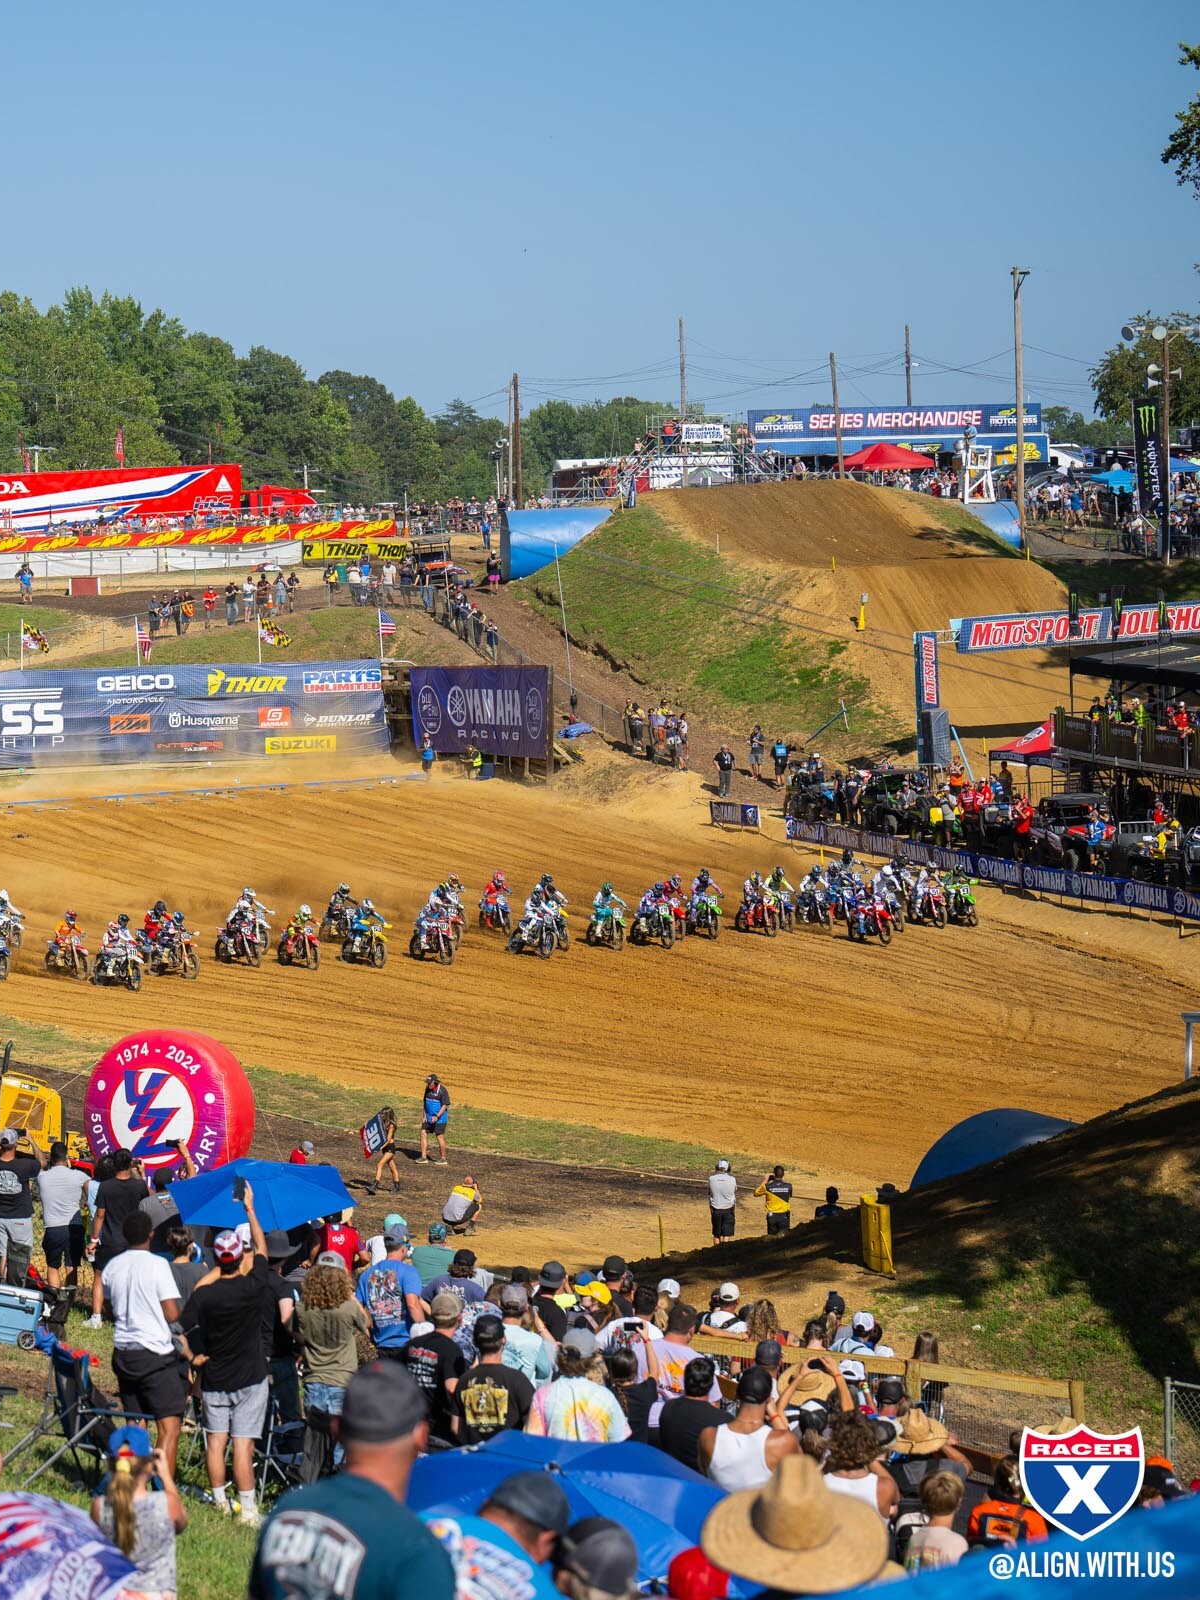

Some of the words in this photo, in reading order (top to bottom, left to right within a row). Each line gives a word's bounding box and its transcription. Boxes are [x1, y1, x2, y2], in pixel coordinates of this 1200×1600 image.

[867, 410, 982, 428] MERCHANDISE
[1147, 440, 1161, 501] MONSTER
[138, 530, 185, 546] FMF
[190, 526, 238, 545] FMF
[295, 522, 342, 541] FMF
[347, 520, 394, 538] FMF
[303, 669, 382, 684] PARTS
[925, 637, 935, 704] MOTOSPORT
[96, 674, 175, 692] GEICO
[226, 675, 288, 692] THOR
[304, 682, 382, 693] UNLIMITED
[107, 696, 165, 705] MOTORCYCLE
[465, 688, 522, 726] YAMAHA
[182, 715, 239, 726] Husqvarna
[319, 713, 376, 723] DUNLOP
[457, 730, 520, 741] RACING
[270, 739, 332, 751] SUZUKI
[941, 850, 972, 874] YAMAHA
[988, 860, 1020, 885] YAMAHA
[1032, 867, 1066, 892] YAMAHA
[1081, 874, 1117, 899] YAMAHA
[1134, 883, 1169, 909] YAMAHA
[116, 1042, 149, 1067] 1974
[165, 1045, 201, 1076] 2024
